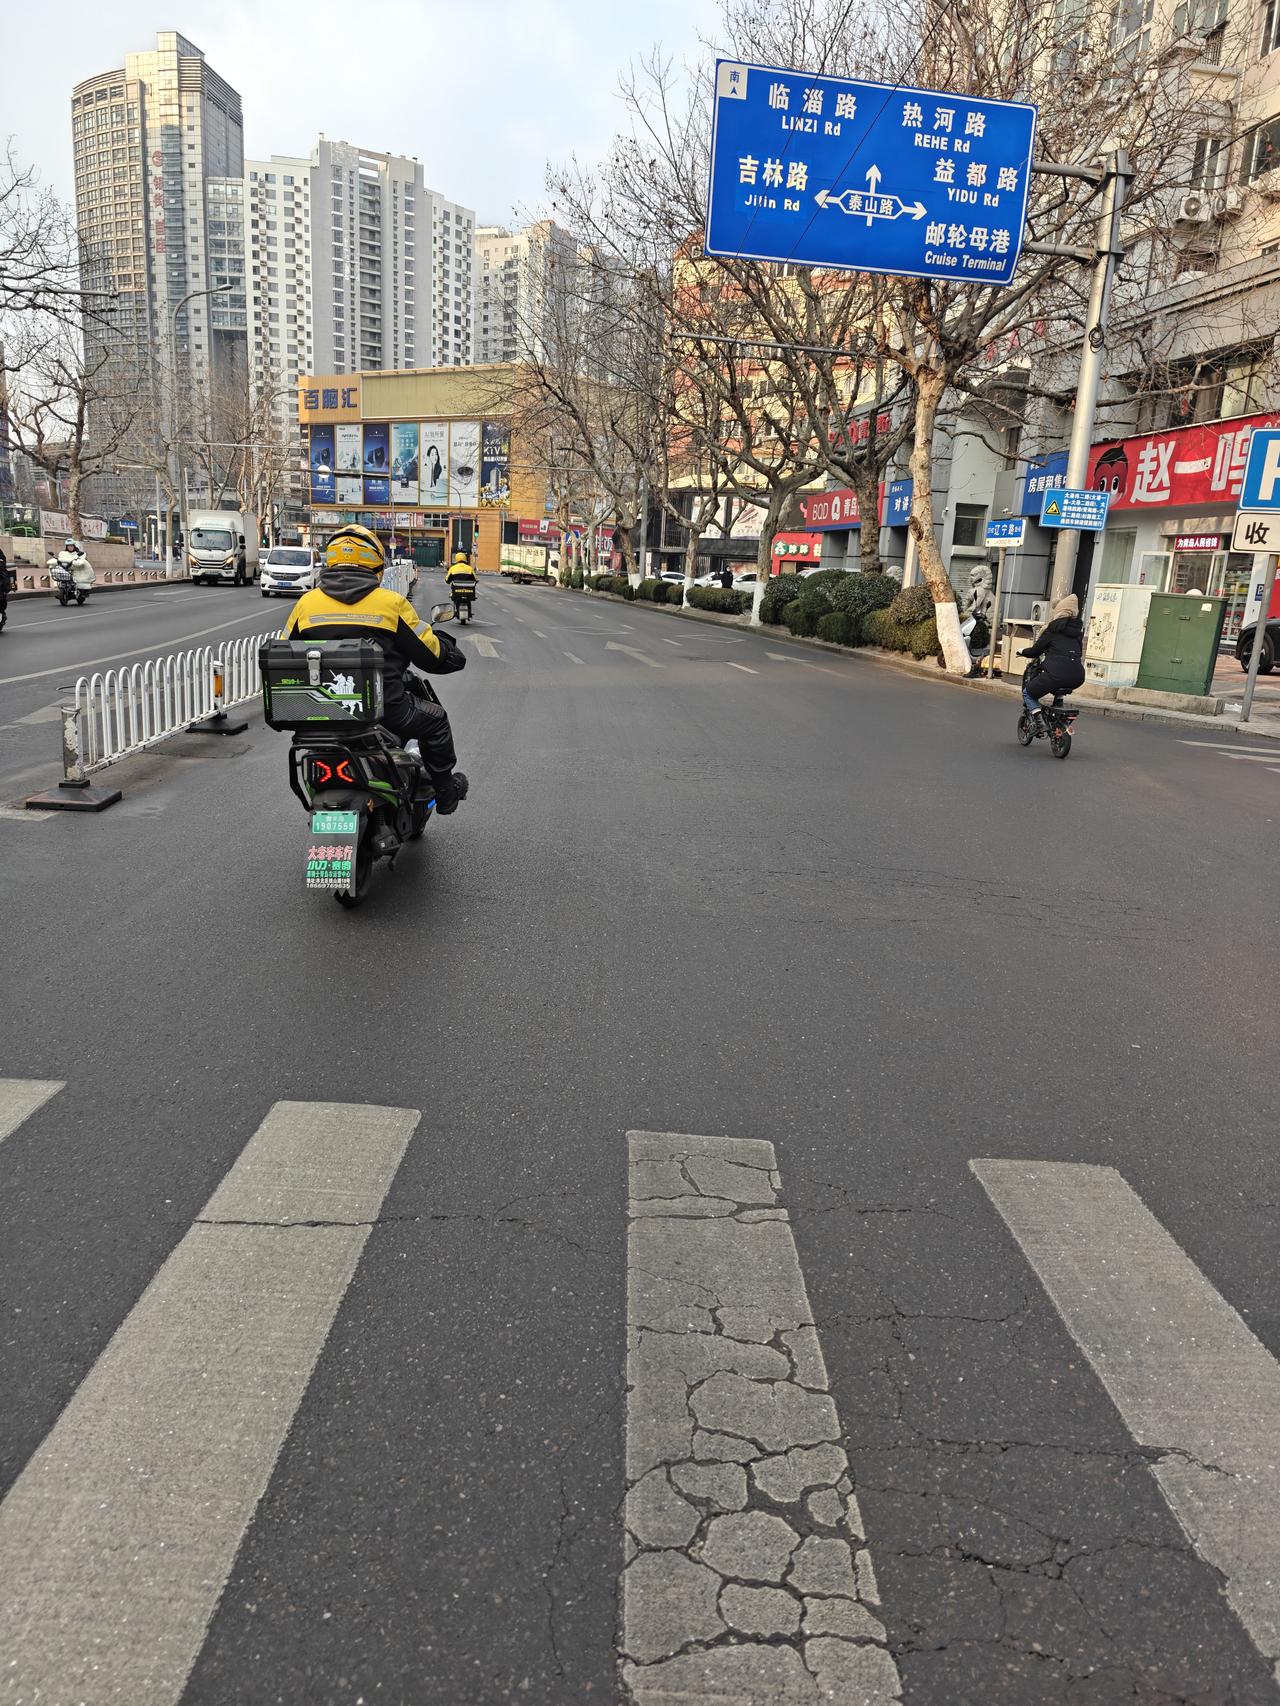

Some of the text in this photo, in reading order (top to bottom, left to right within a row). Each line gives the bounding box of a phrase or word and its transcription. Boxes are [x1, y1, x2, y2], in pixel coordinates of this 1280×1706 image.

[729, 70, 741, 83] 南
[769, 83, 857, 120] 临淄路
[781, 115, 841, 137] LINZI Rd
[902, 101, 987, 137] 热河路
[914, 133, 970, 153] REHE Rd
[738, 154, 809, 191] 吉林路
[933, 158, 1019, 193] 益都路
[744, 194, 800, 212] Jilin Rd
[848, 193, 894, 216] 泰山路
[947, 187, 1000, 208] YIDU Rd
[924, 221, 1010, 255] 邮轮母港
[924, 250, 1007, 272] Cruise Terminal
[303, 387, 358, 410] 百脑汇
[812, 502, 829, 520] BQD
[1245, 522, 1270, 545] 收
